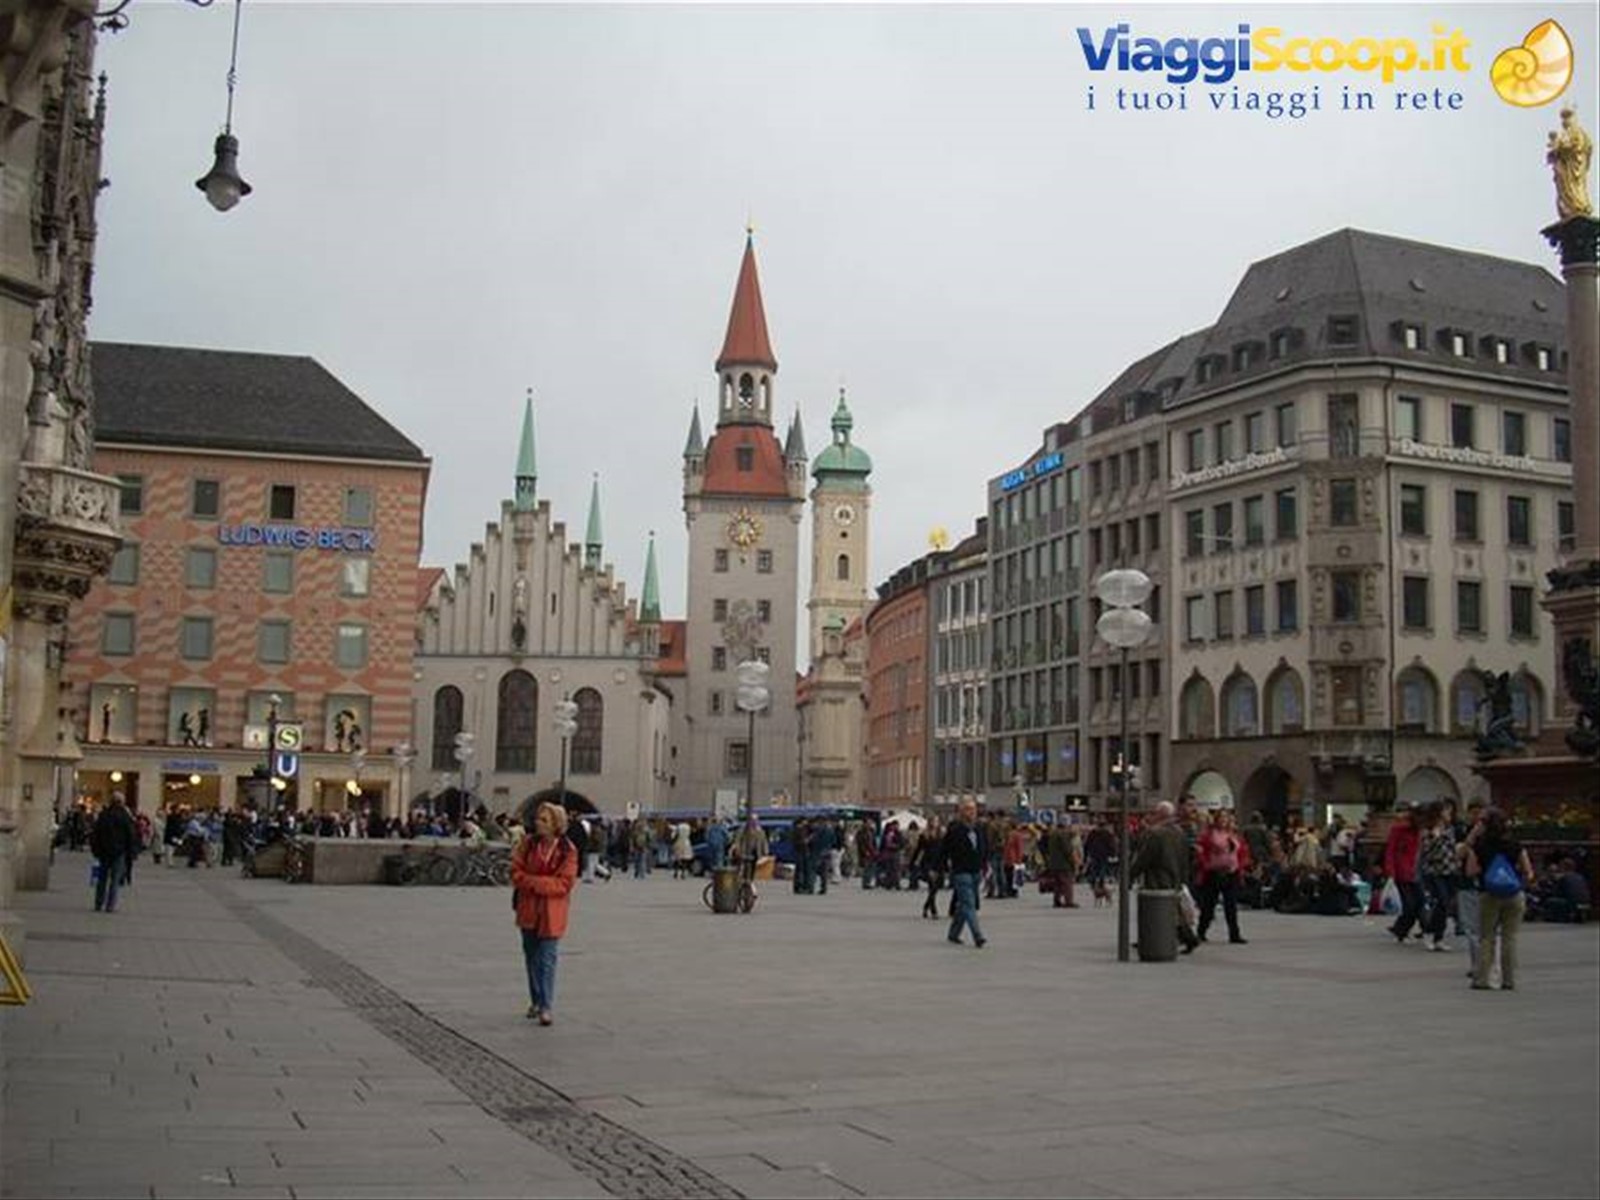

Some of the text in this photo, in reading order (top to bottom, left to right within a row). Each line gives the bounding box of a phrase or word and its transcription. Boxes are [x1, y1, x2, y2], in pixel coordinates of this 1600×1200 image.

[218, 523, 376, 552] LUDWIG BECK
[277, 754, 297, 777] U
